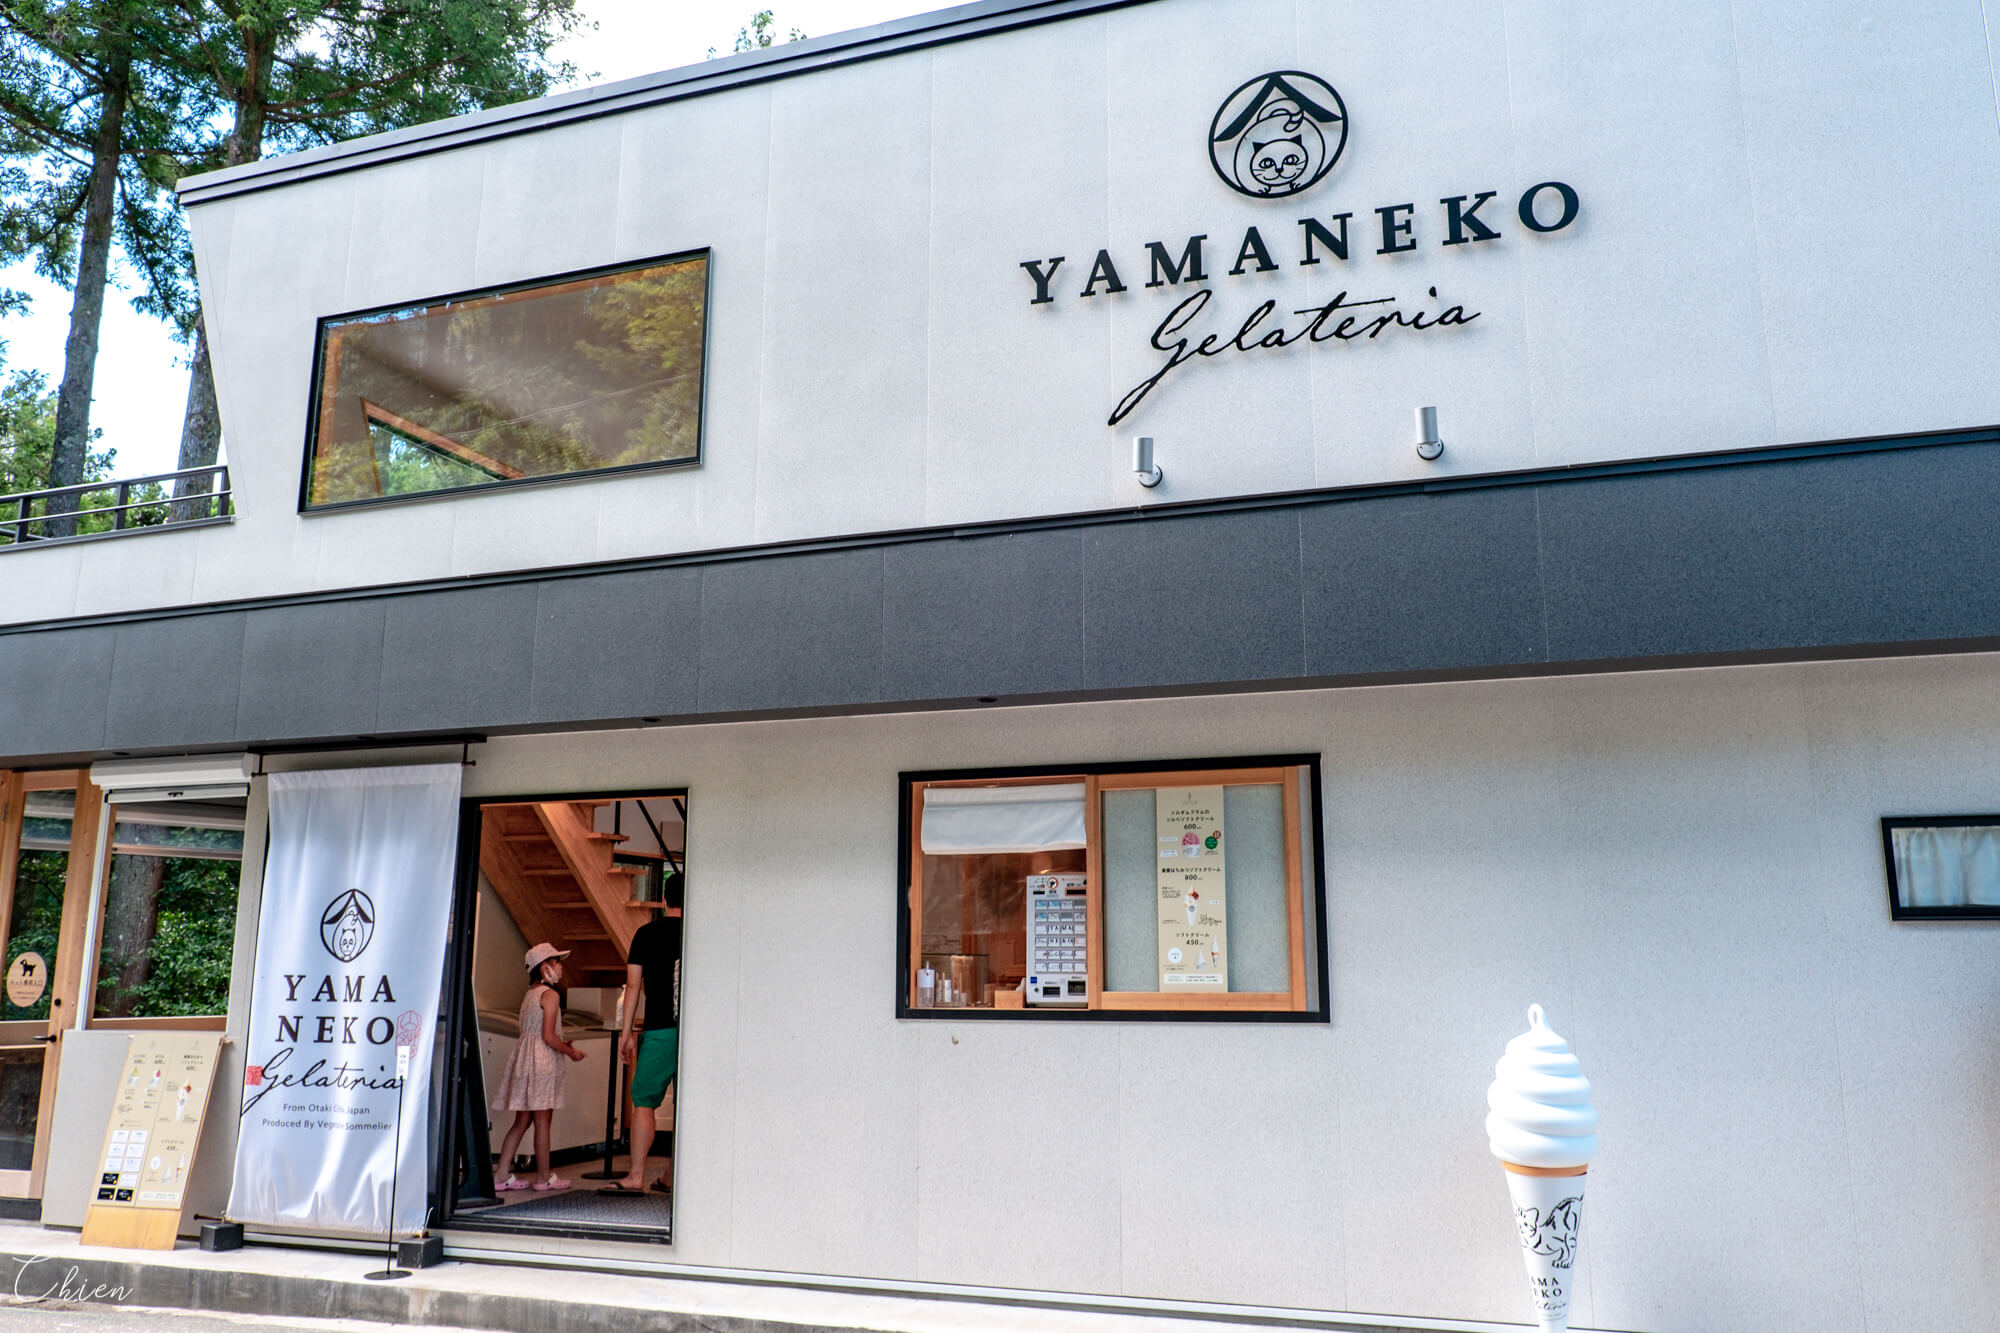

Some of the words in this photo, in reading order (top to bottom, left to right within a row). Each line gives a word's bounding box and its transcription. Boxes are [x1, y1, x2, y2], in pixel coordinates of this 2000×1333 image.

[1020, 181, 1580, 305] YAMANEKO
[1108, 287, 1481, 426] Gelateria
[283, 974, 397, 1003] YAMA
[275, 1015, 395, 1045] NEKO
[240, 1047, 402, 1118] Gelateria
[262, 1118, 301, 1128] Produced
[304, 1119, 315, 1130] By
[345, 1121, 392, 1131] Sommelier
[283, 1103, 306, 1112] From
[308, 1103, 332, 1113] Otaki
[346, 1104, 370, 1116] Japan
